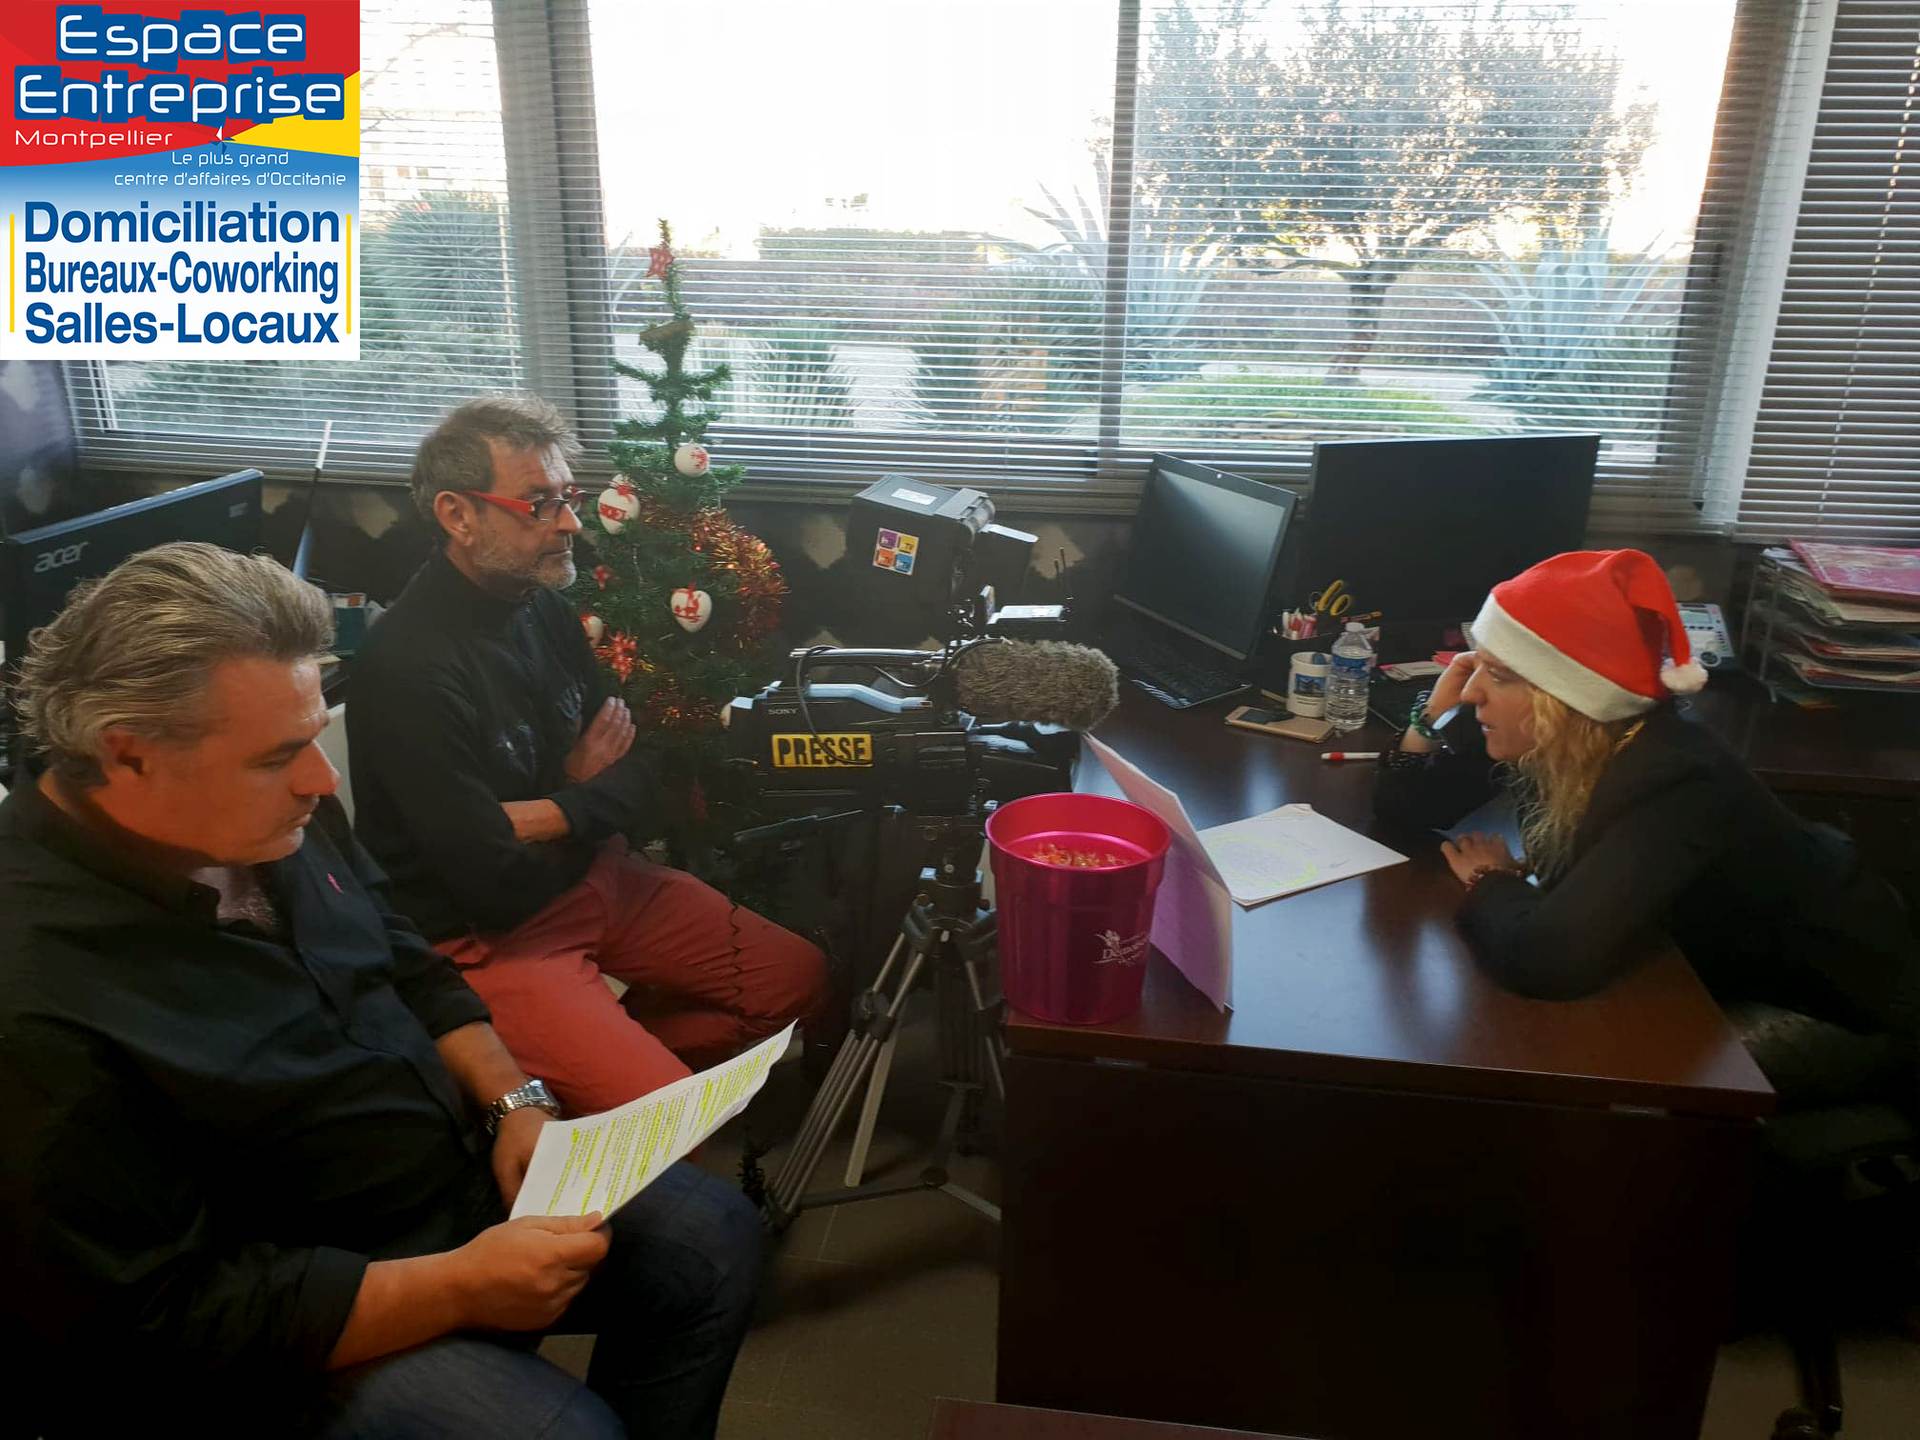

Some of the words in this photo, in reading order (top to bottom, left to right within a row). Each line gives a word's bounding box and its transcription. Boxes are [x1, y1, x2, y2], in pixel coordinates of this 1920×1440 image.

[34, 541, 89, 573] acer
[768, 707, 799, 715] SONY
[776, 736, 866, 766] PRESSE
